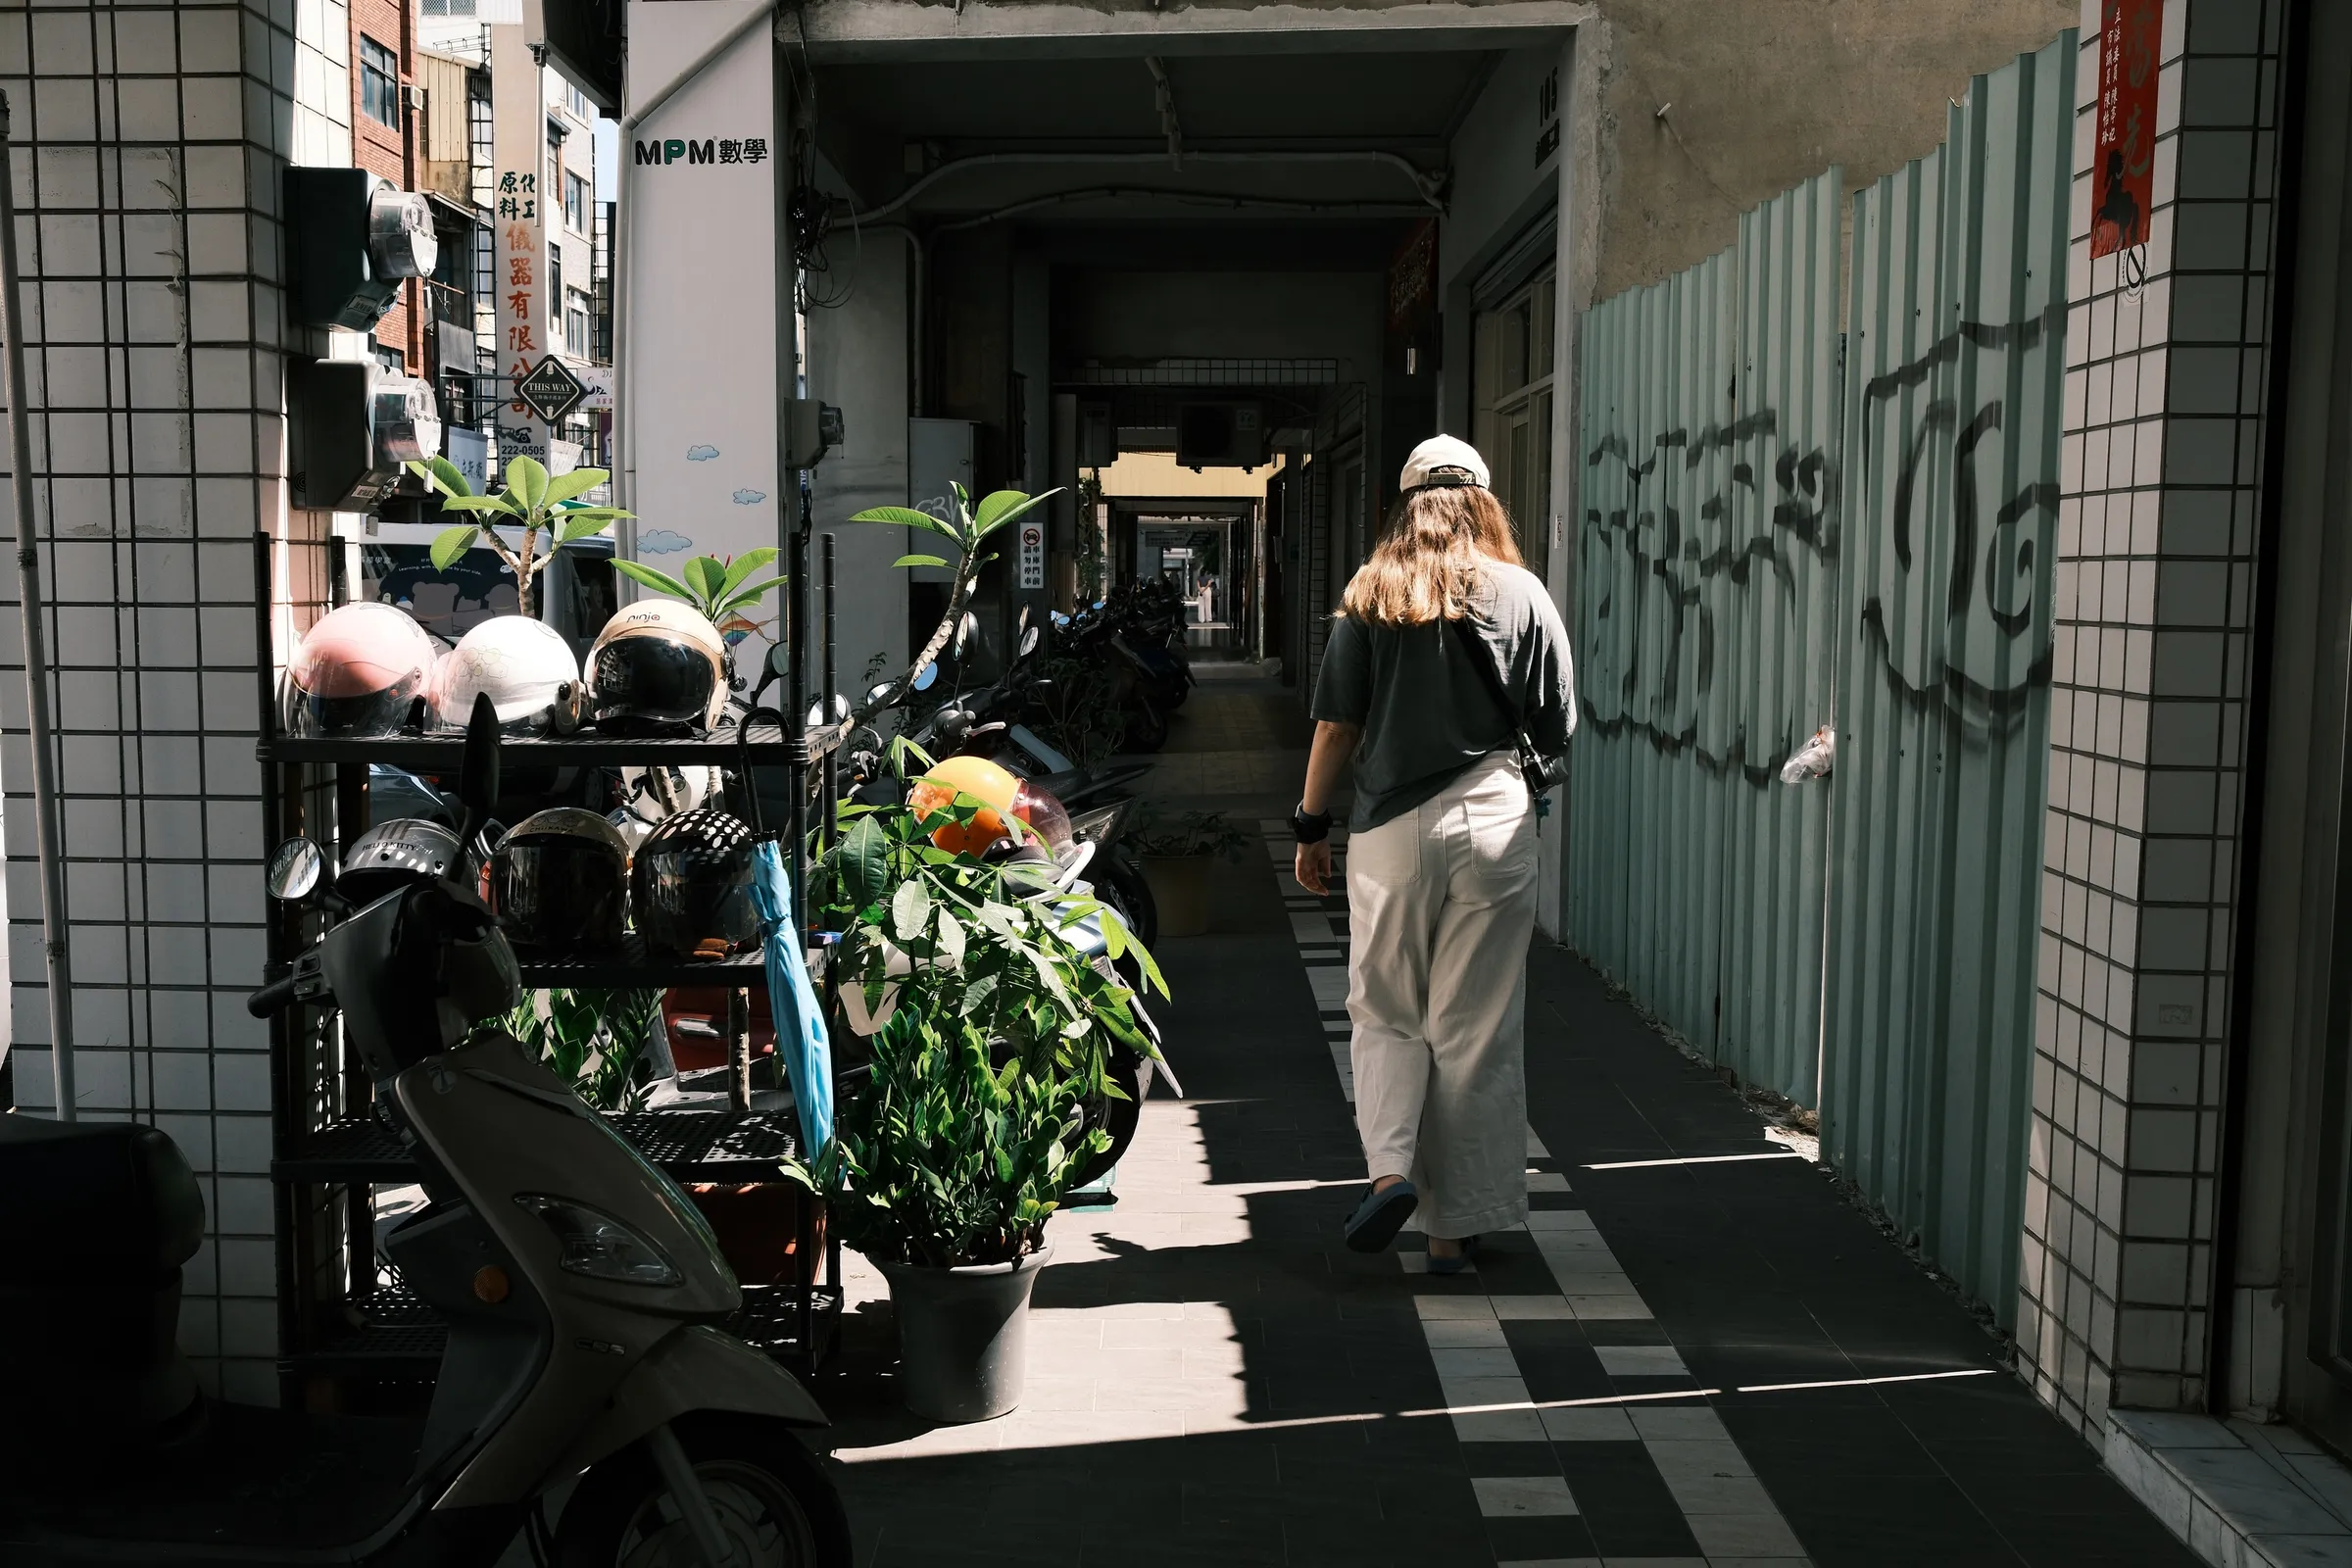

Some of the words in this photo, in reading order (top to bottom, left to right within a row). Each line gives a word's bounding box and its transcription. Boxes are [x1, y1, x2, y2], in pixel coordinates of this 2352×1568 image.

[1540, 67, 1558, 126] 105
[718, 138, 767, 165] 數學
[528, 382, 550, 391] THIS
[552, 383, 571, 392] WAY
[502, 445, 545, 455] 222-0505
[1023, 546, 1032, 585] 請勿停車
[362, 842, 388, 852] HELLO
[390, 841, 416, 851] KITTY
